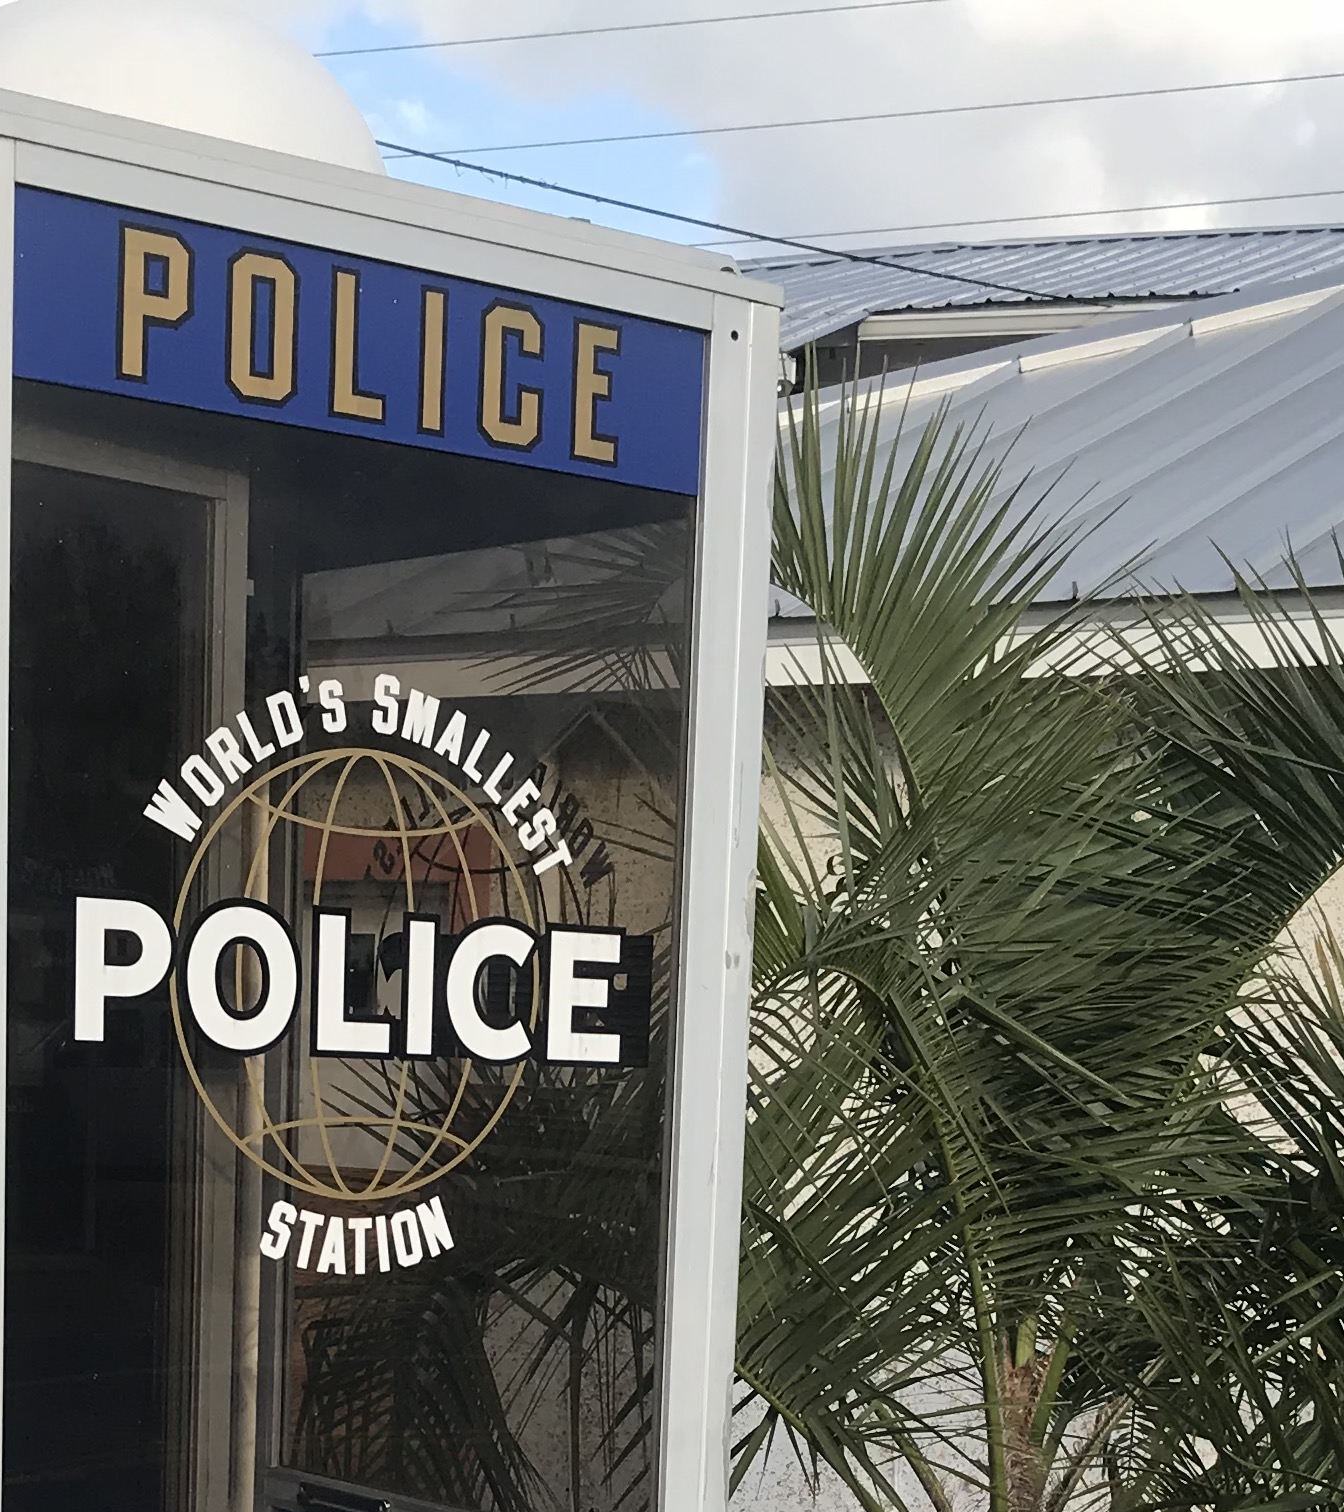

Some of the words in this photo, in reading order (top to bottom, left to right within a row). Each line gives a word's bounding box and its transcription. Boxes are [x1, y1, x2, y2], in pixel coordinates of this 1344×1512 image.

[115, 220, 621, 467] POLICE
[142, 675, 347, 843] WORLD'S
[372, 673, 574, 876] SMALLEST
[74, 896, 626, 1066] POLICE
[260, 1195, 455, 1276] STATION
